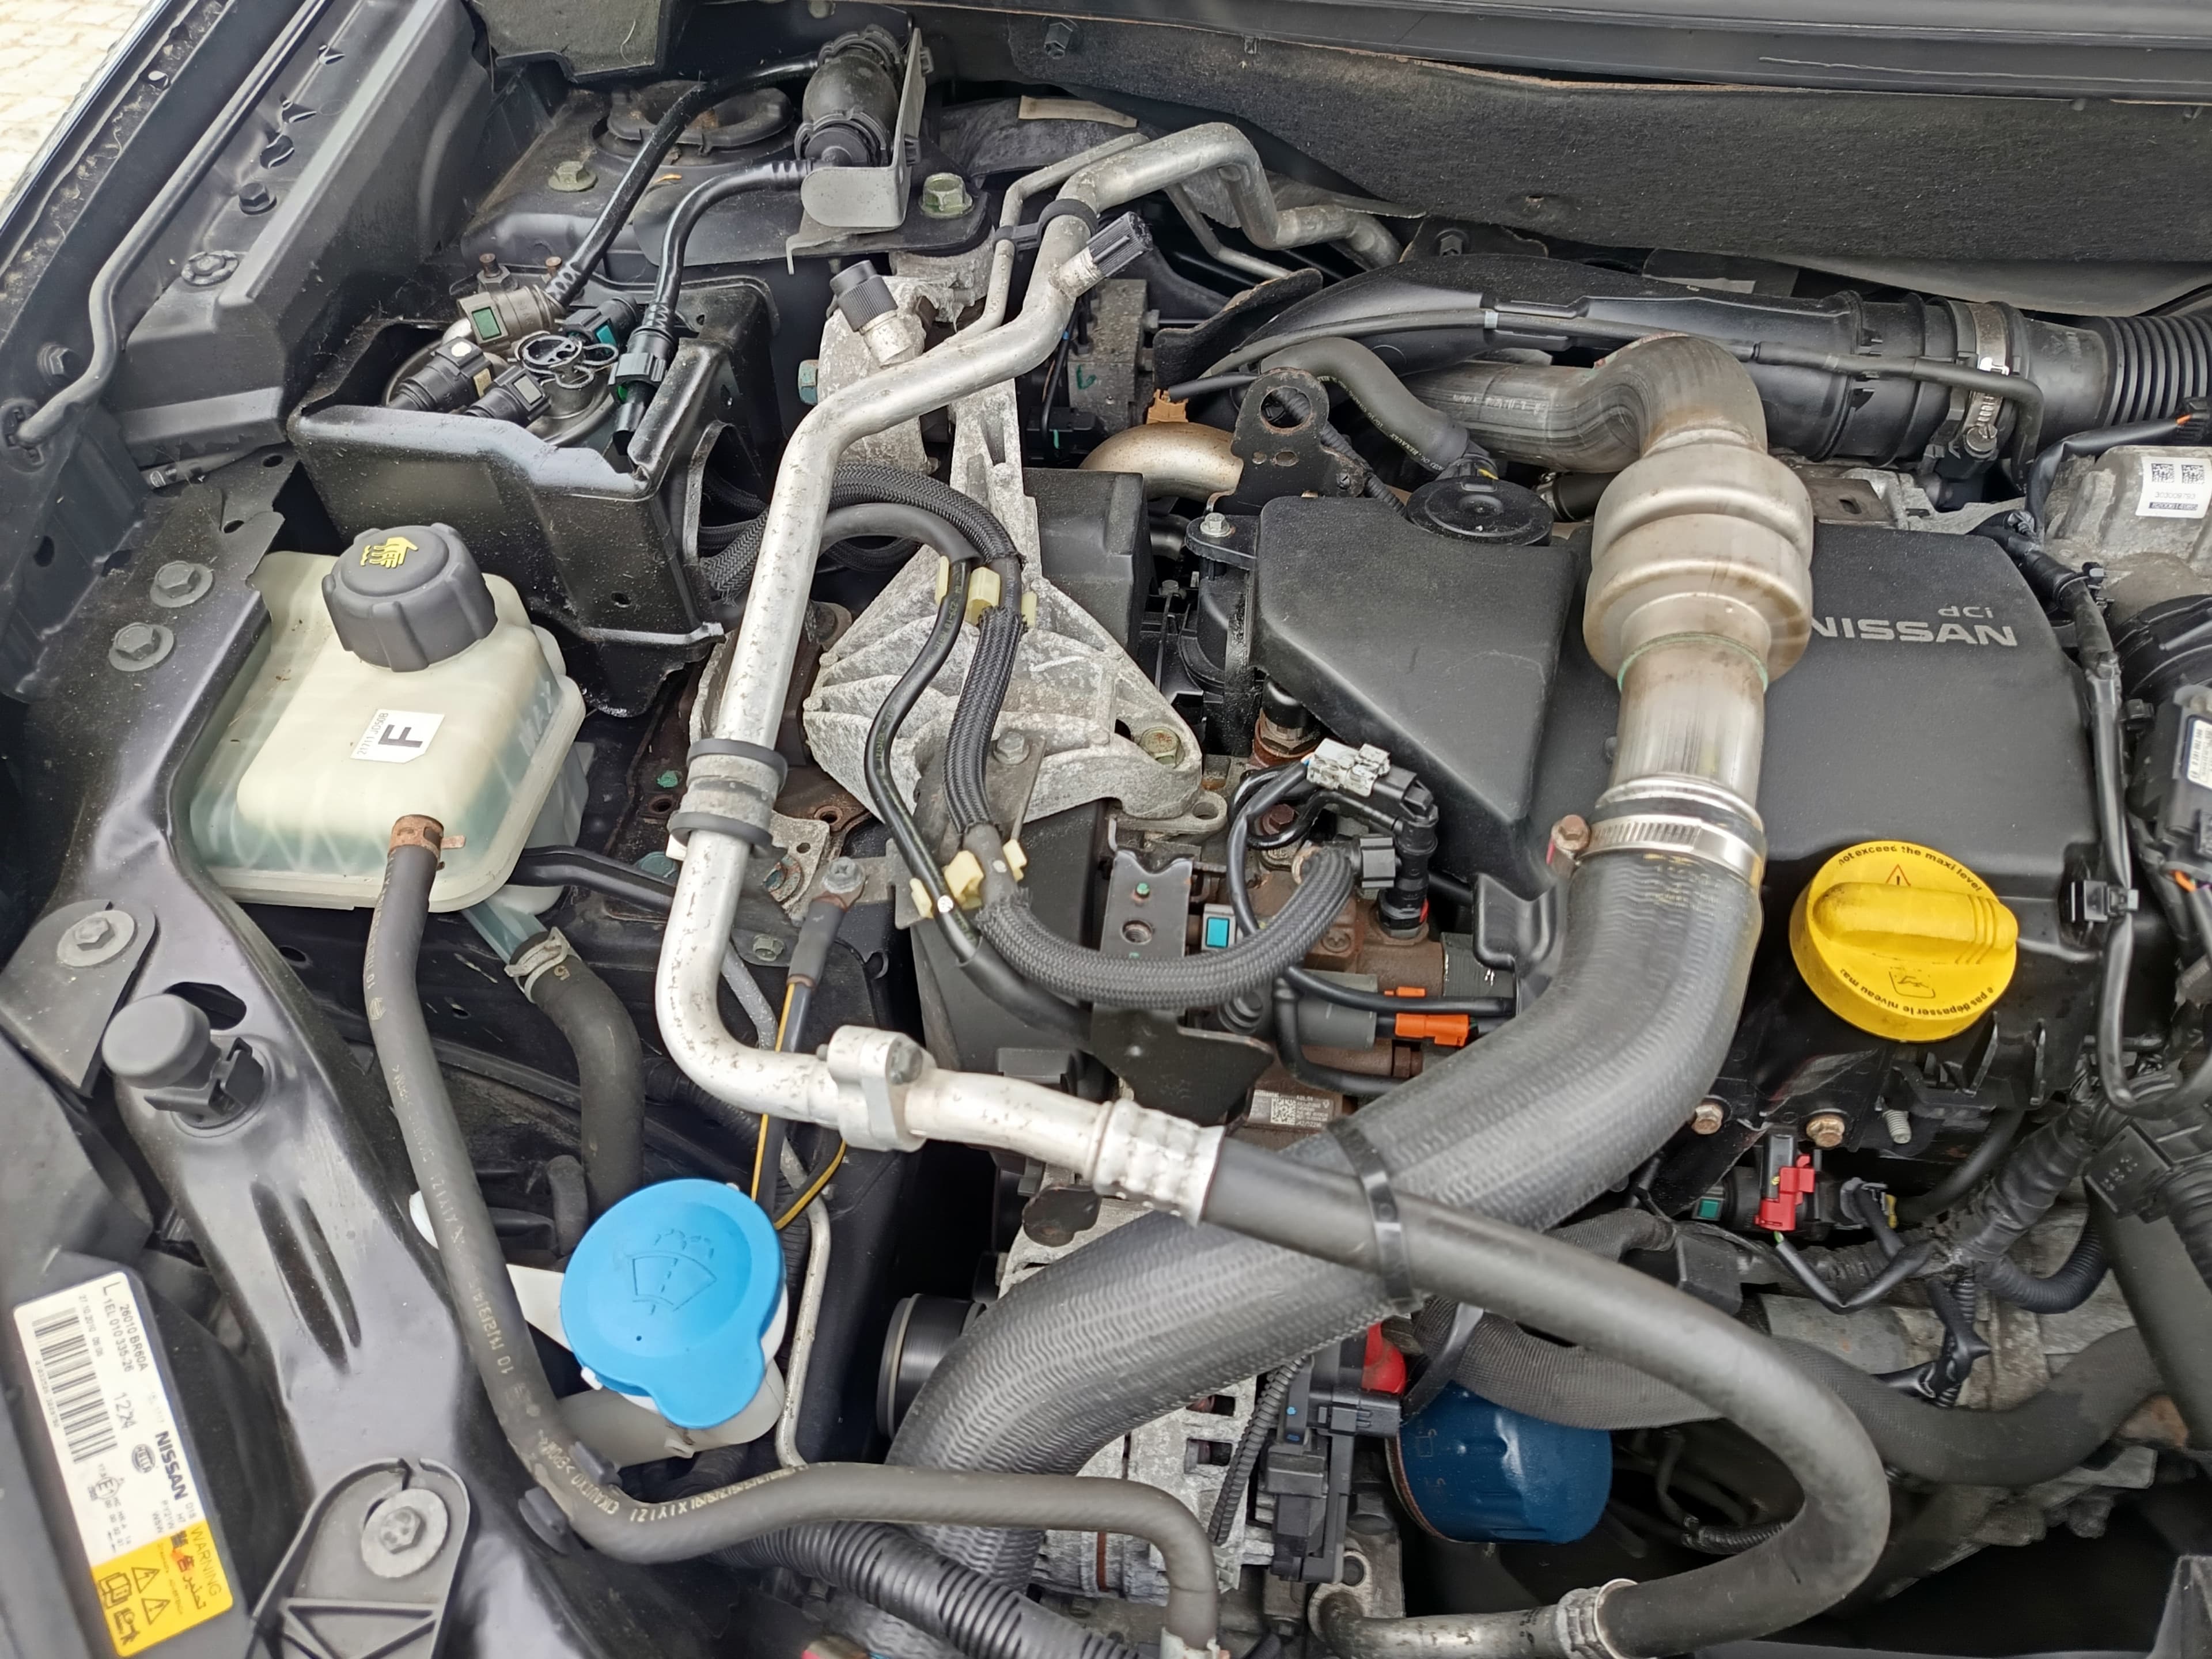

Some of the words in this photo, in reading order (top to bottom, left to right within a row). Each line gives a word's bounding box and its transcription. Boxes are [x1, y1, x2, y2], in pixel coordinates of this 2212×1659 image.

[1937, 605, 1994, 619] dCi
[1812, 616, 2018, 647] NISSAN
[379, 725, 423, 748] F
[1901, 846, 1921, 856] the
[1925, 852, 1956, 871] maxi
[1956, 868, 1983, 892] level
[1860, 986, 1898, 1009] niveau
[1903, 1006, 1913, 1015] le
[109, 1318, 123, 1337] 010
[120, 1305, 138, 1334] 26010
[155, 1431, 189, 1500] NISSAN
[190, 1527, 222, 1596] WARNING
